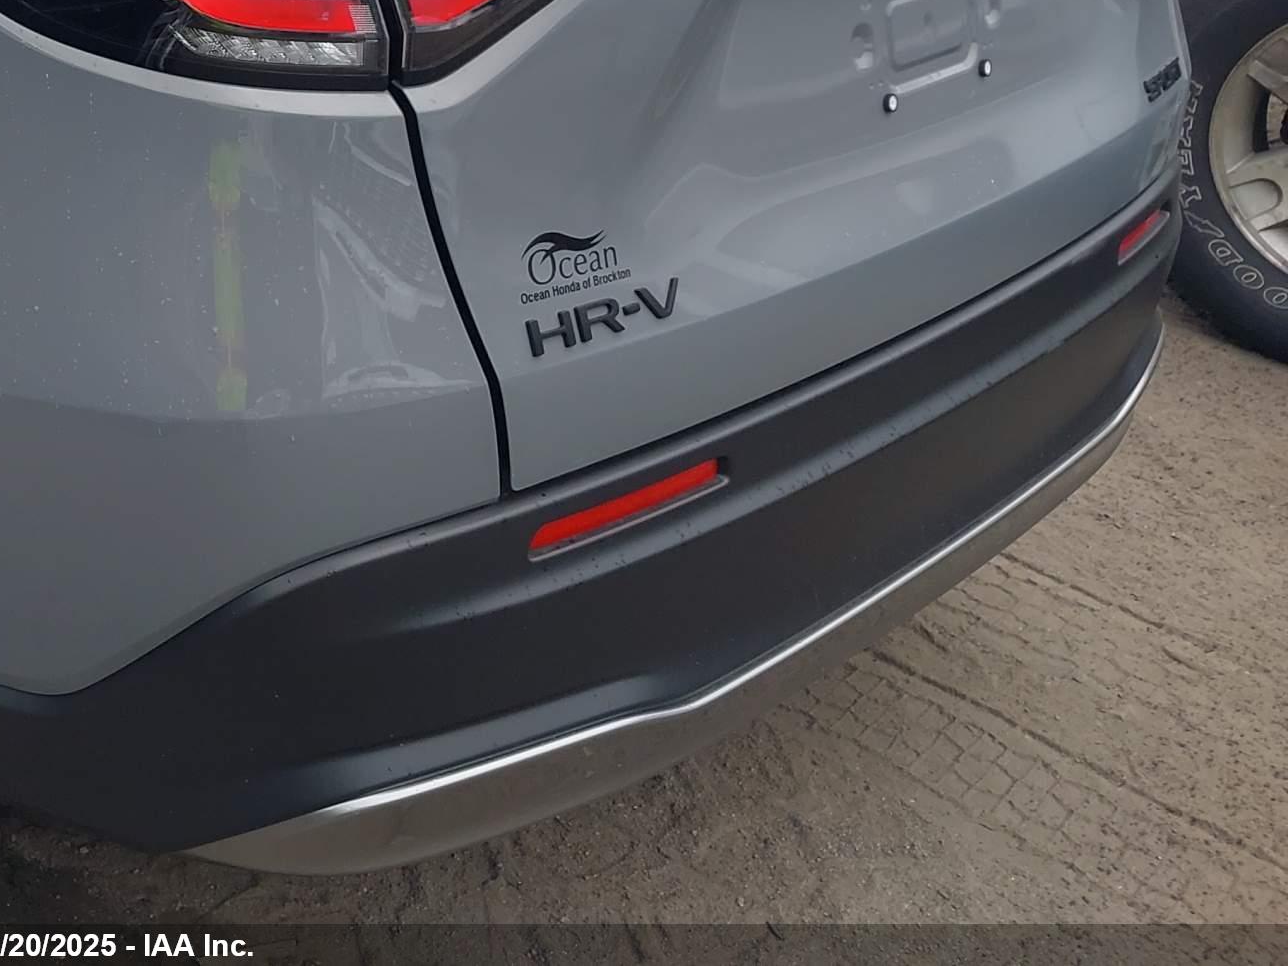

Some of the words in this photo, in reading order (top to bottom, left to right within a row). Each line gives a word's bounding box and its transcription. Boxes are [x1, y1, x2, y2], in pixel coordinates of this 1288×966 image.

[528, 246, 618, 285] Ocean
[520, 289, 551, 305] Ocean
[552, 282, 581, 297] Honda
[582, 277, 592, 289] of
[593, 268, 632, 287] Brockton
[524, 277, 679, 357] HR-V
